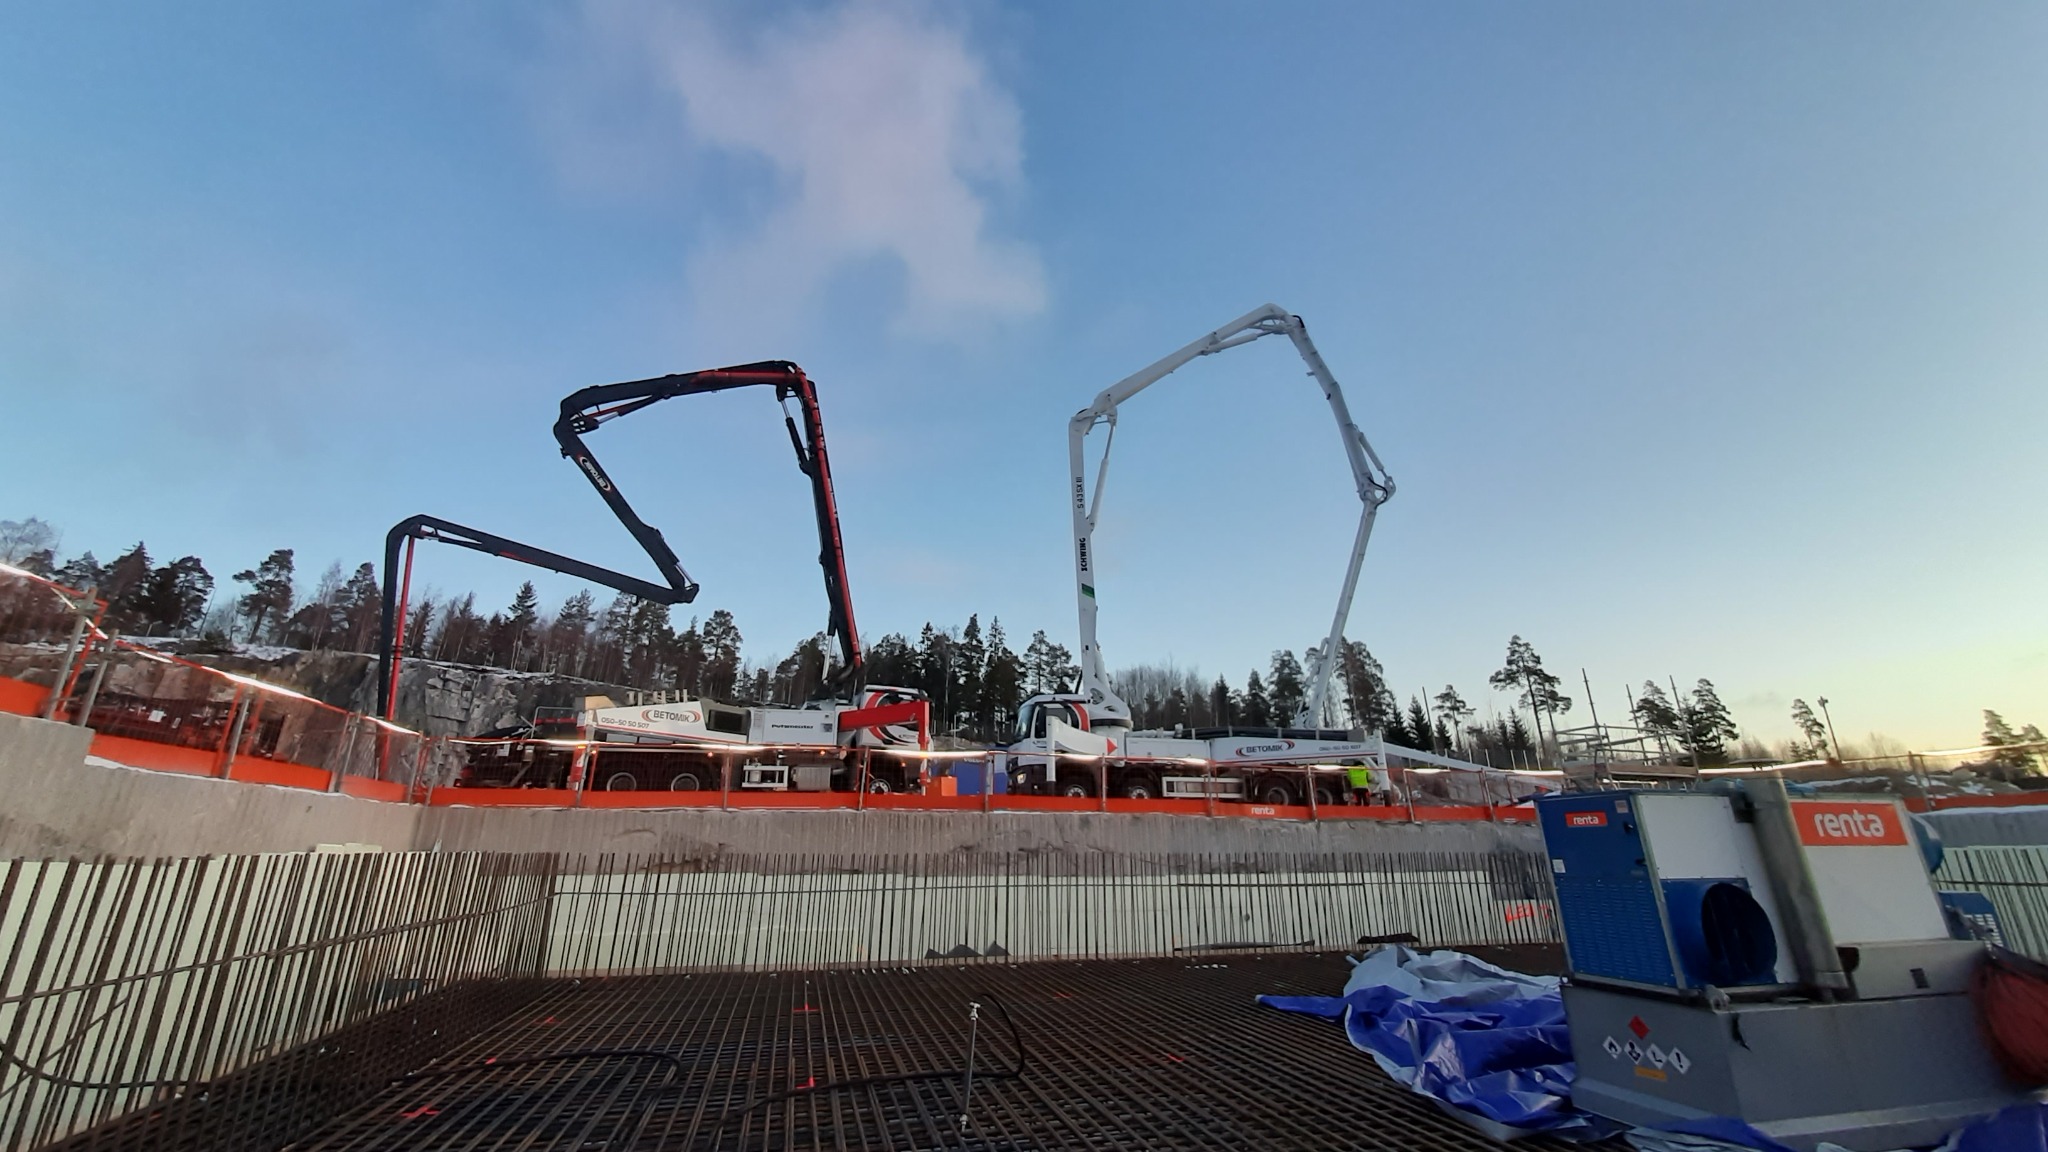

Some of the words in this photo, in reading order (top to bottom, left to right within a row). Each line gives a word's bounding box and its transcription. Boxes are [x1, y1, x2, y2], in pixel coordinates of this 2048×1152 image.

[1079, 537, 1088, 572] SCHWING
[653, 709, 690, 722] BETOMIK
[1246, 744, 1283, 754] BETOMIK
[1251, 806, 1275, 815] renta
[1573, 815, 1599, 825] renta
[1813, 808, 1885, 838] renta
